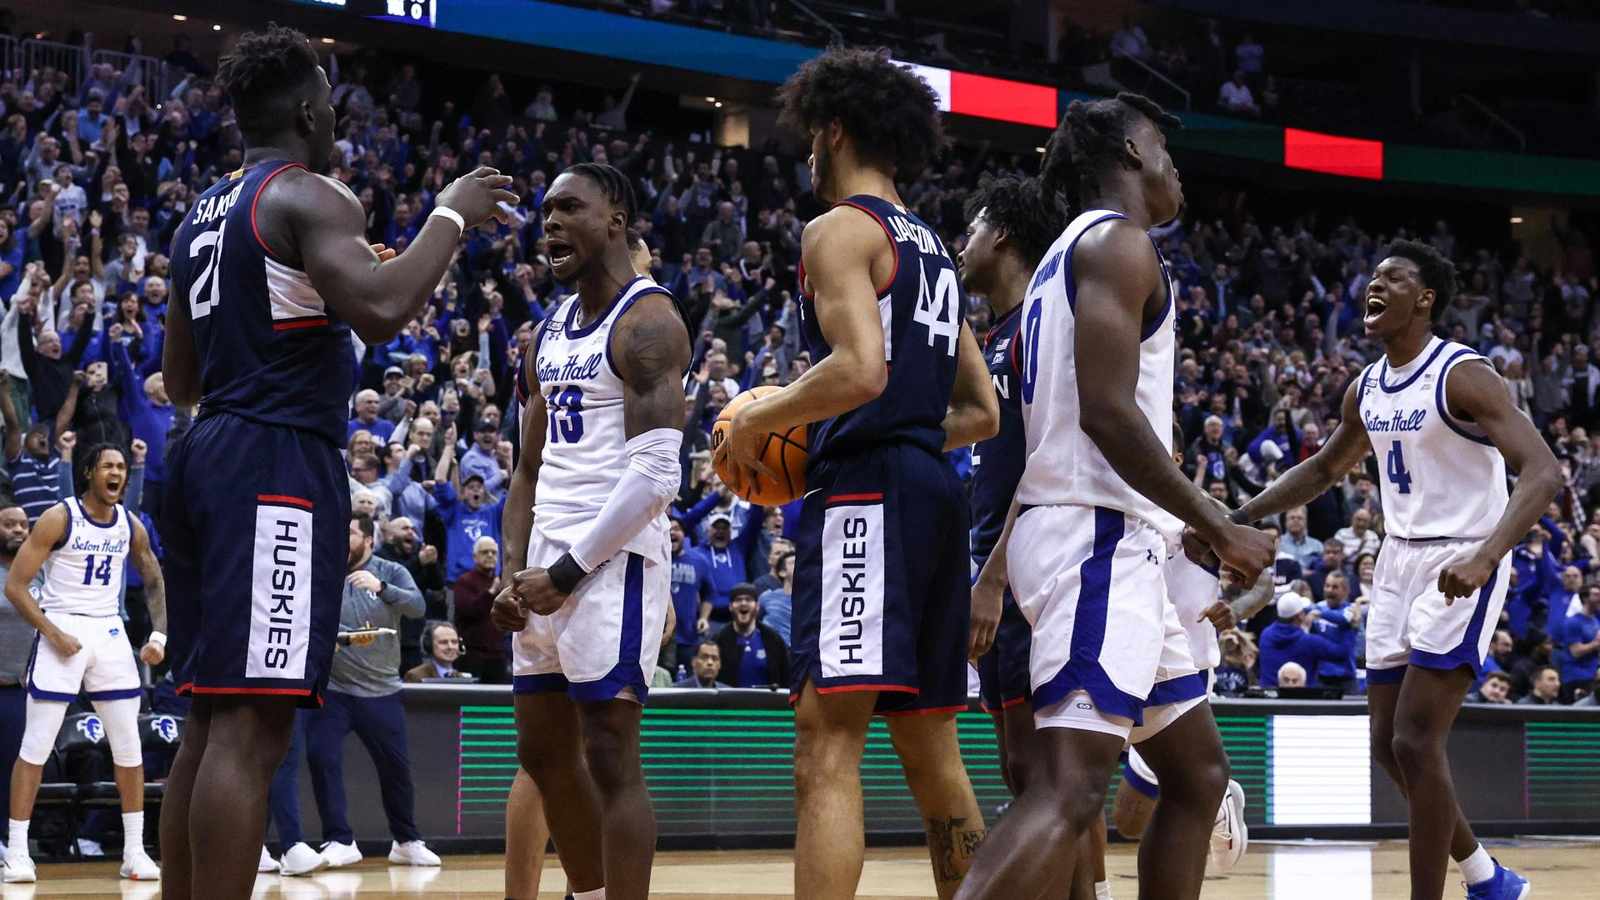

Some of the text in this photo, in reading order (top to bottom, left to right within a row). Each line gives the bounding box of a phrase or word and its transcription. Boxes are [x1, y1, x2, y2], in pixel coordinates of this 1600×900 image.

[189, 219, 226, 320] 21
[913, 257, 960, 357] 44
[538, 352, 602, 382] Seton Hall
[547, 385, 584, 443] 13
[1365, 409, 1426, 432] Seton Hall
[1387, 440, 1412, 494] 4
[72, 536, 127, 553] Seton Hall
[82, 554, 112, 586] 14
[264, 519, 299, 670] HUSKIES
[839, 517, 868, 665] HUSKIES
